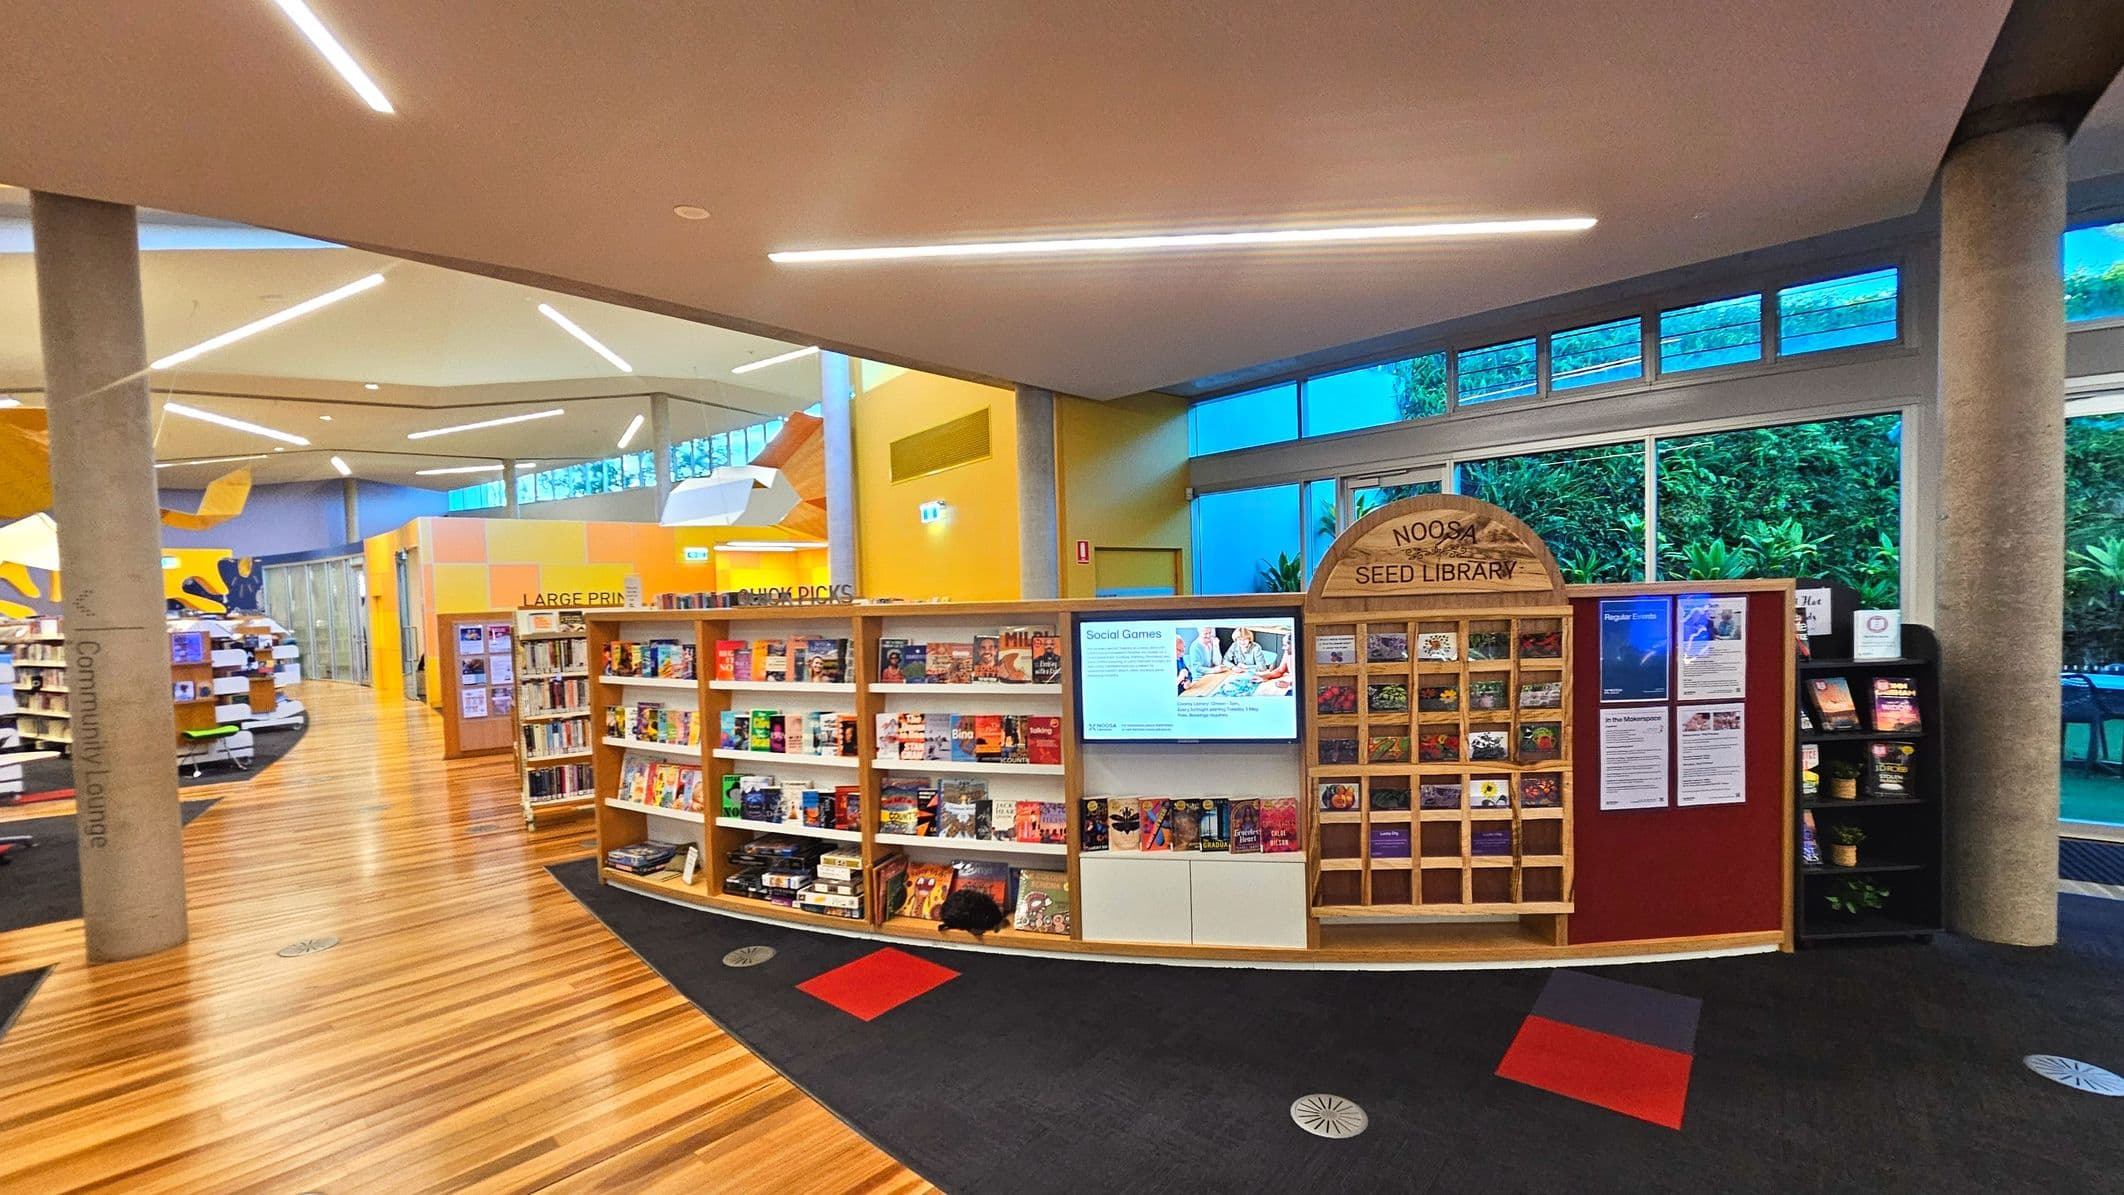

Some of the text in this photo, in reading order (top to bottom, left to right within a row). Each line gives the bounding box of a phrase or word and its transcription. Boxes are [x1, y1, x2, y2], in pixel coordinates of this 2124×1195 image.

[1393, 520, 1478, 546] NOOSA
[1356, 560, 1518, 584] SEED LIBRARY
[523, 593, 583, 606] LARGE
[588, 592, 625, 605] PRIN
[738, 584, 854, 606] QUICK PICKS
[1604, 613, 1631, 622] Regular
[1086, 629, 1162, 640] Social Games
[76, 641, 112, 849] Community Lounge
[1203, 841, 1228, 849] GRADUA
